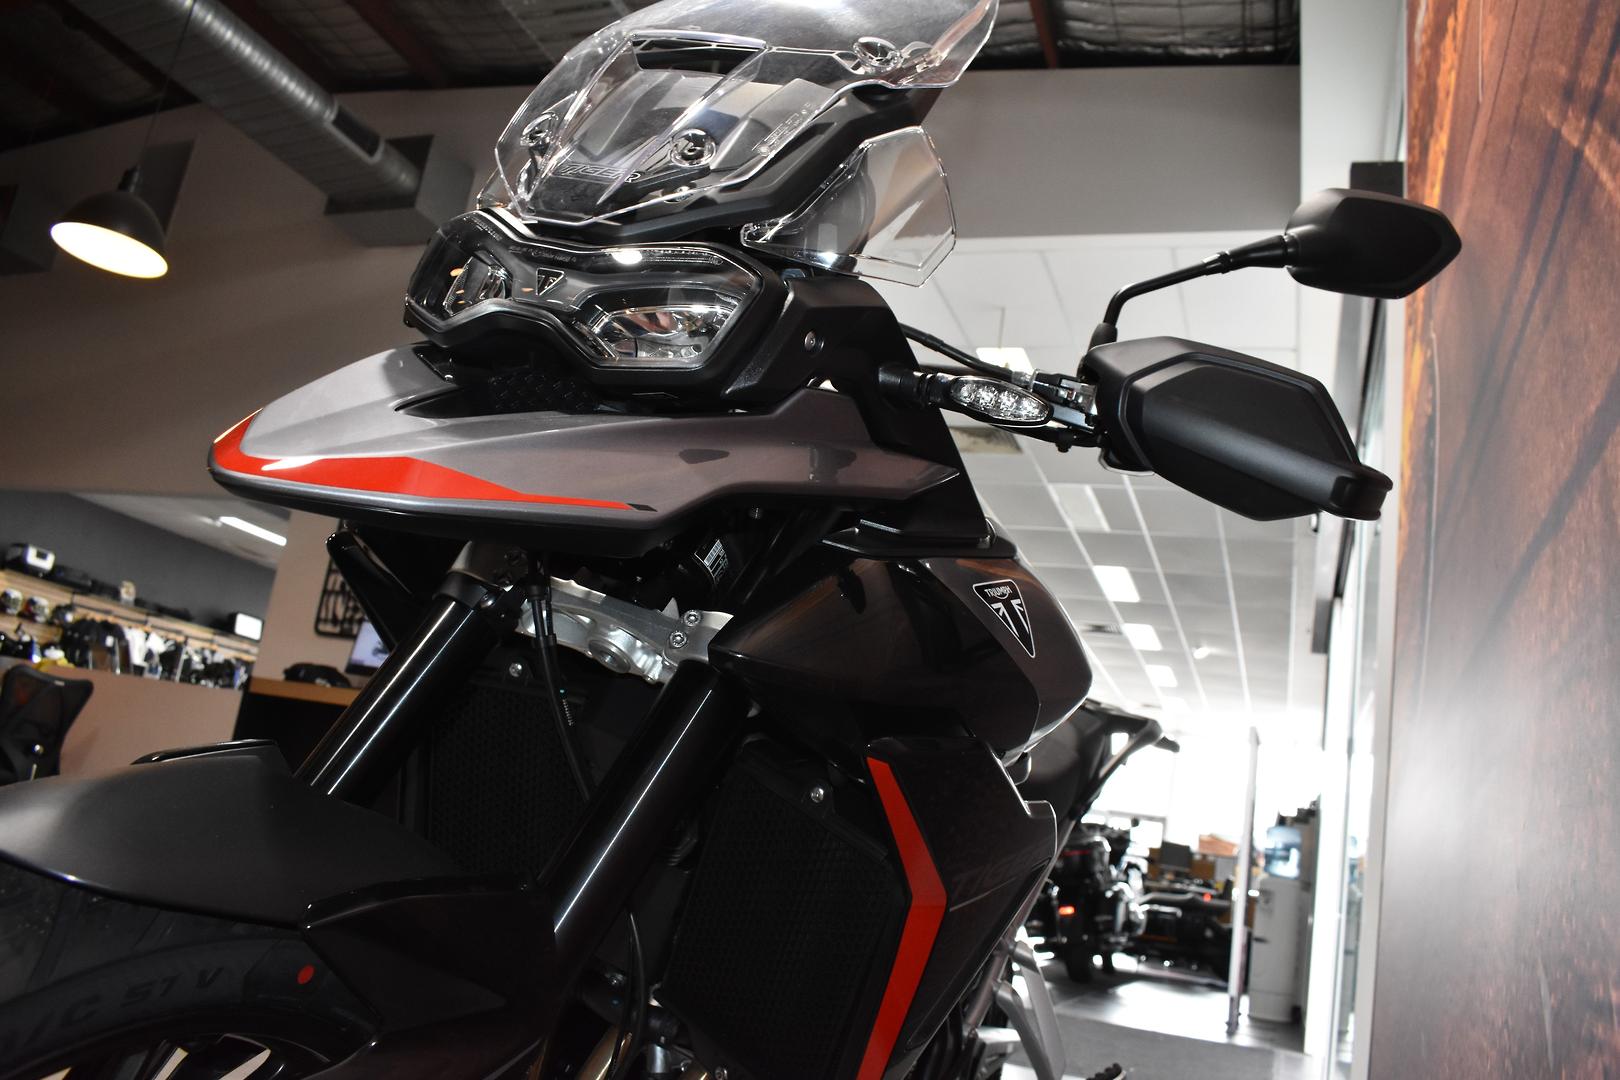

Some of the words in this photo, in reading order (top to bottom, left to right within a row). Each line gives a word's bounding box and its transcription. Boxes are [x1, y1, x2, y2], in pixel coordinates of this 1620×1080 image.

[562, 164, 641, 183] TIGER
[984, 585, 1013, 599] TRIUMPH
[197, 966, 225, 989] V
